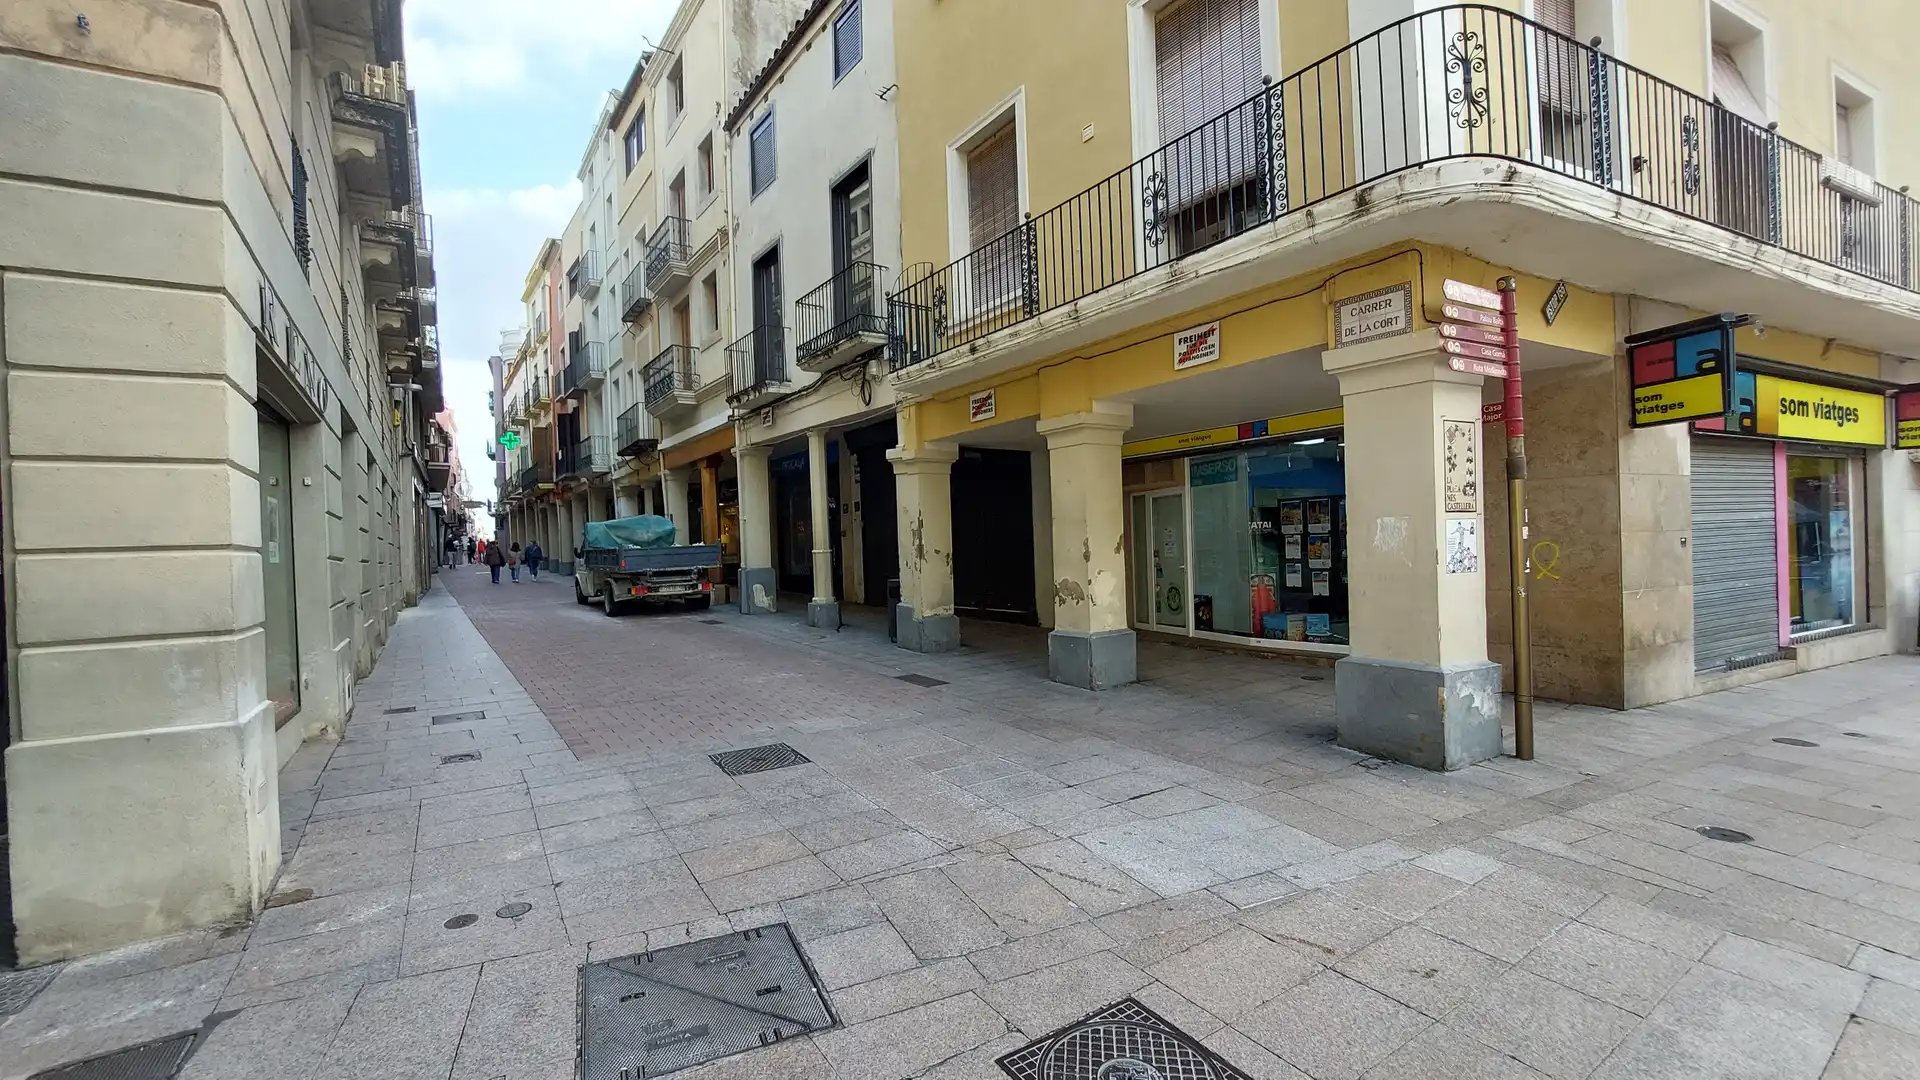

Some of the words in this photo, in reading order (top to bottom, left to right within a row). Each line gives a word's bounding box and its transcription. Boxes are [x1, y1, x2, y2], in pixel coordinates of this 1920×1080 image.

[1350, 298, 1393, 317] CARRER
[1344, 326, 1357, 338] DE
[1360, 323, 1372, 334] LA
[1373, 315, 1401, 330] CORT
[1178, 328, 1216, 346] FREIHEIT
[1635, 393, 1663, 404] som
[1483, 405, 1502, 413] Casa
[1635, 401, 1685, 415] viatges
[1780, 397, 1809, 418] som
[1812, 398, 1859, 428] viatges
[1446, 476, 1453, 484] LA
[1446, 502, 1475, 511] CASTELLERA
